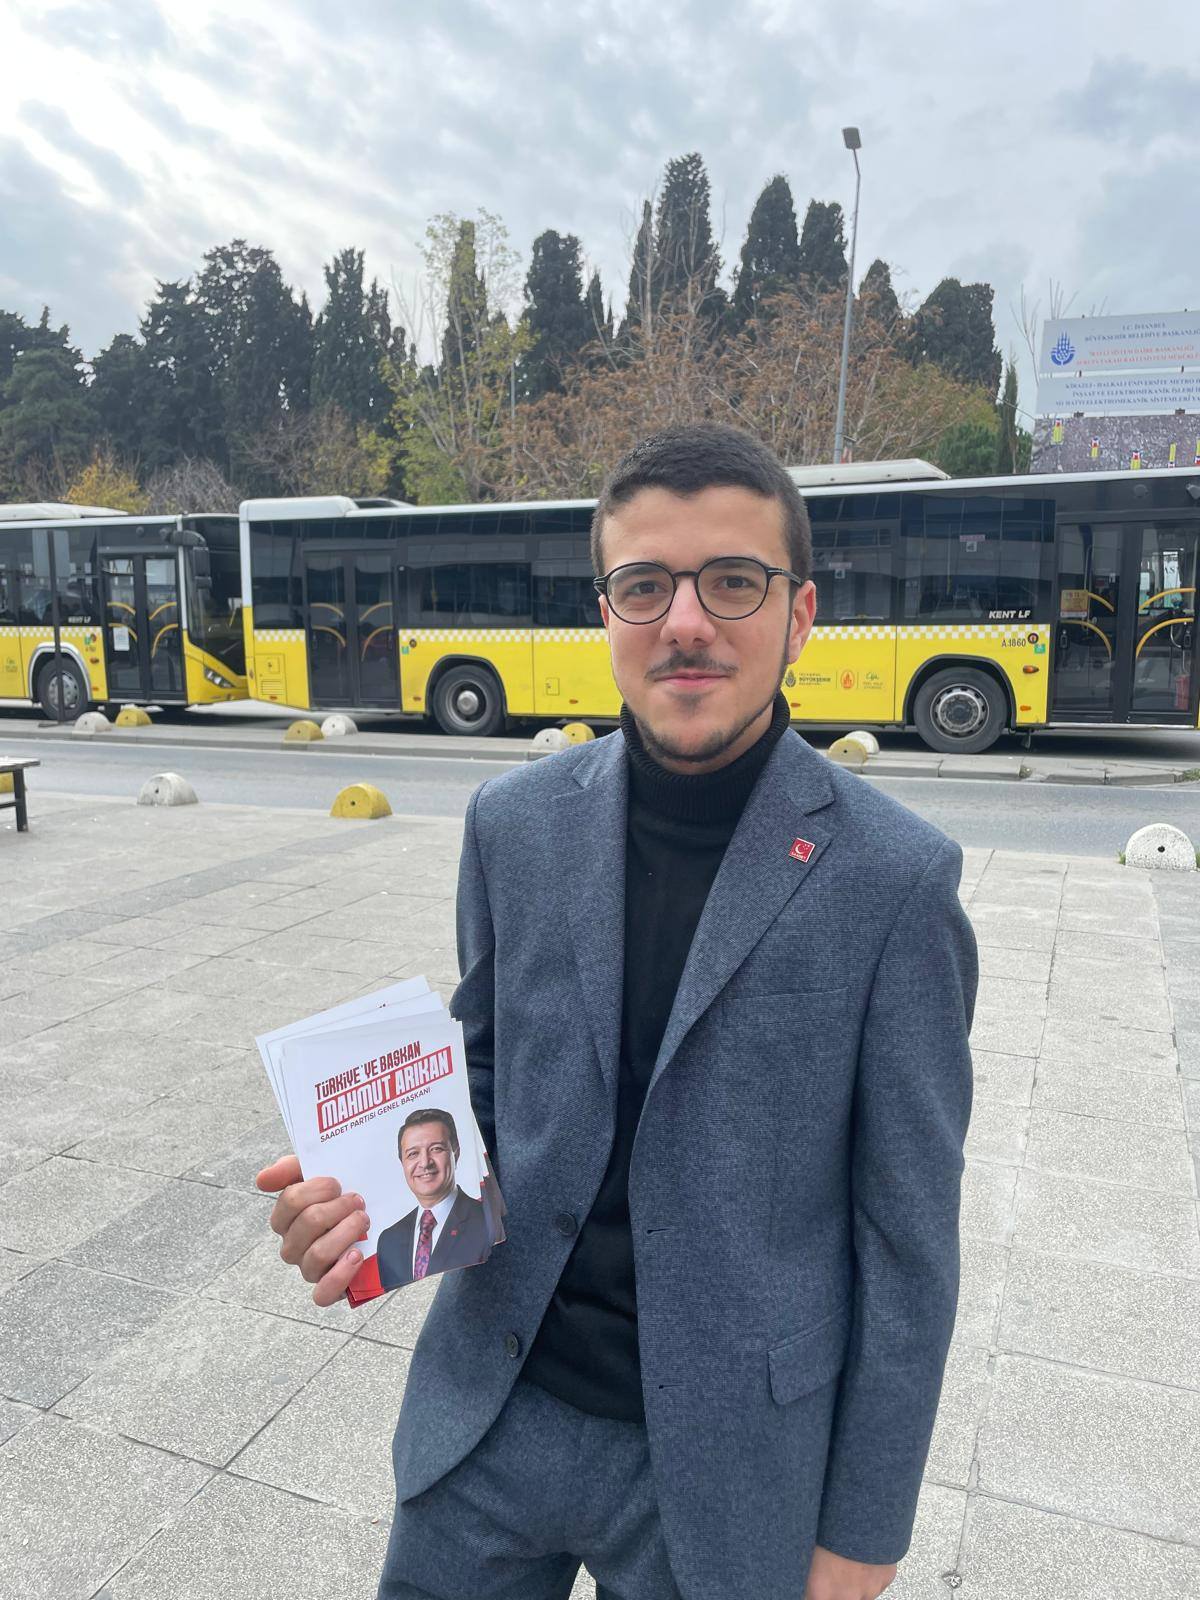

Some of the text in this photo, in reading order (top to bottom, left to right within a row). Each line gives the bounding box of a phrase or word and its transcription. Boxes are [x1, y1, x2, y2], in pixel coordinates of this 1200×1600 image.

[989, 610, 1031, 619] KENT LF
[379, 1041, 421, 1073] BAŞKAN
[320, 1049, 450, 1131] MAHMUT ARIKAN
[320, 1124, 349, 1143] SAADET
[377, 1101, 400, 1116] GENEL
